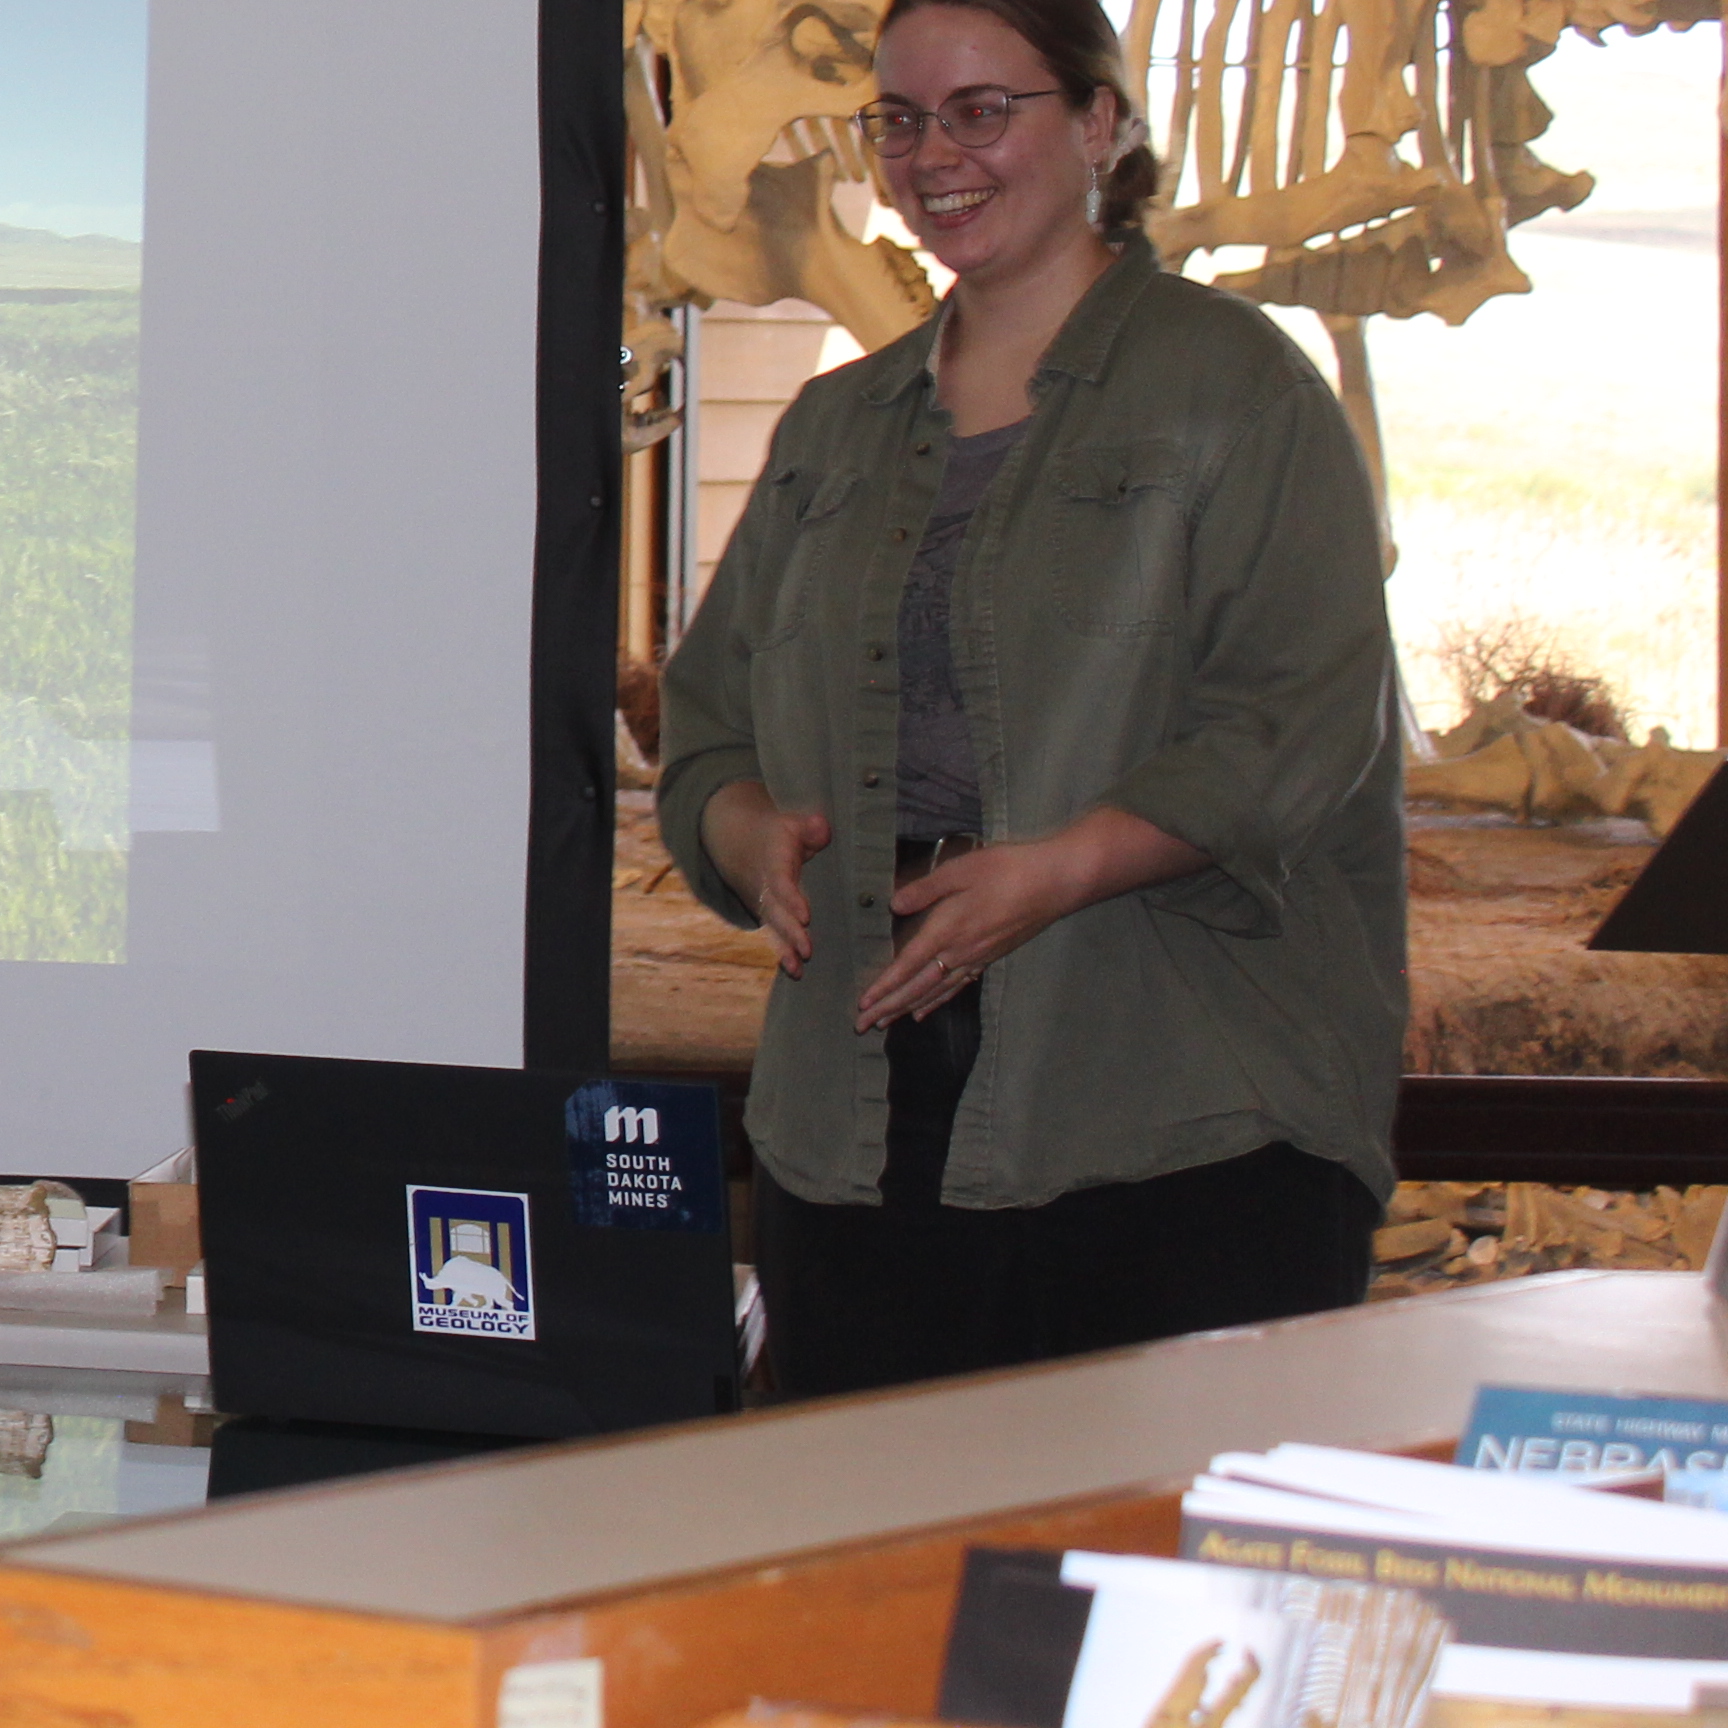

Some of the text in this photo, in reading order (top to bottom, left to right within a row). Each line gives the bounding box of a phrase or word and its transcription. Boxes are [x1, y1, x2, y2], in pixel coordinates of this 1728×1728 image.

[606, 1153, 670, 1172] SOUTH
[607, 1172, 682, 1191] DAKOTA
[608, 1190, 669, 1208] MINES
[418, 1306, 529, 1323] MUSEUM OF
[419, 1315, 530, 1334] GEOLOGY
[1551, 1412, 1610, 1435] STATE
[1615, 1417, 1707, 1444] HIGHWAY
